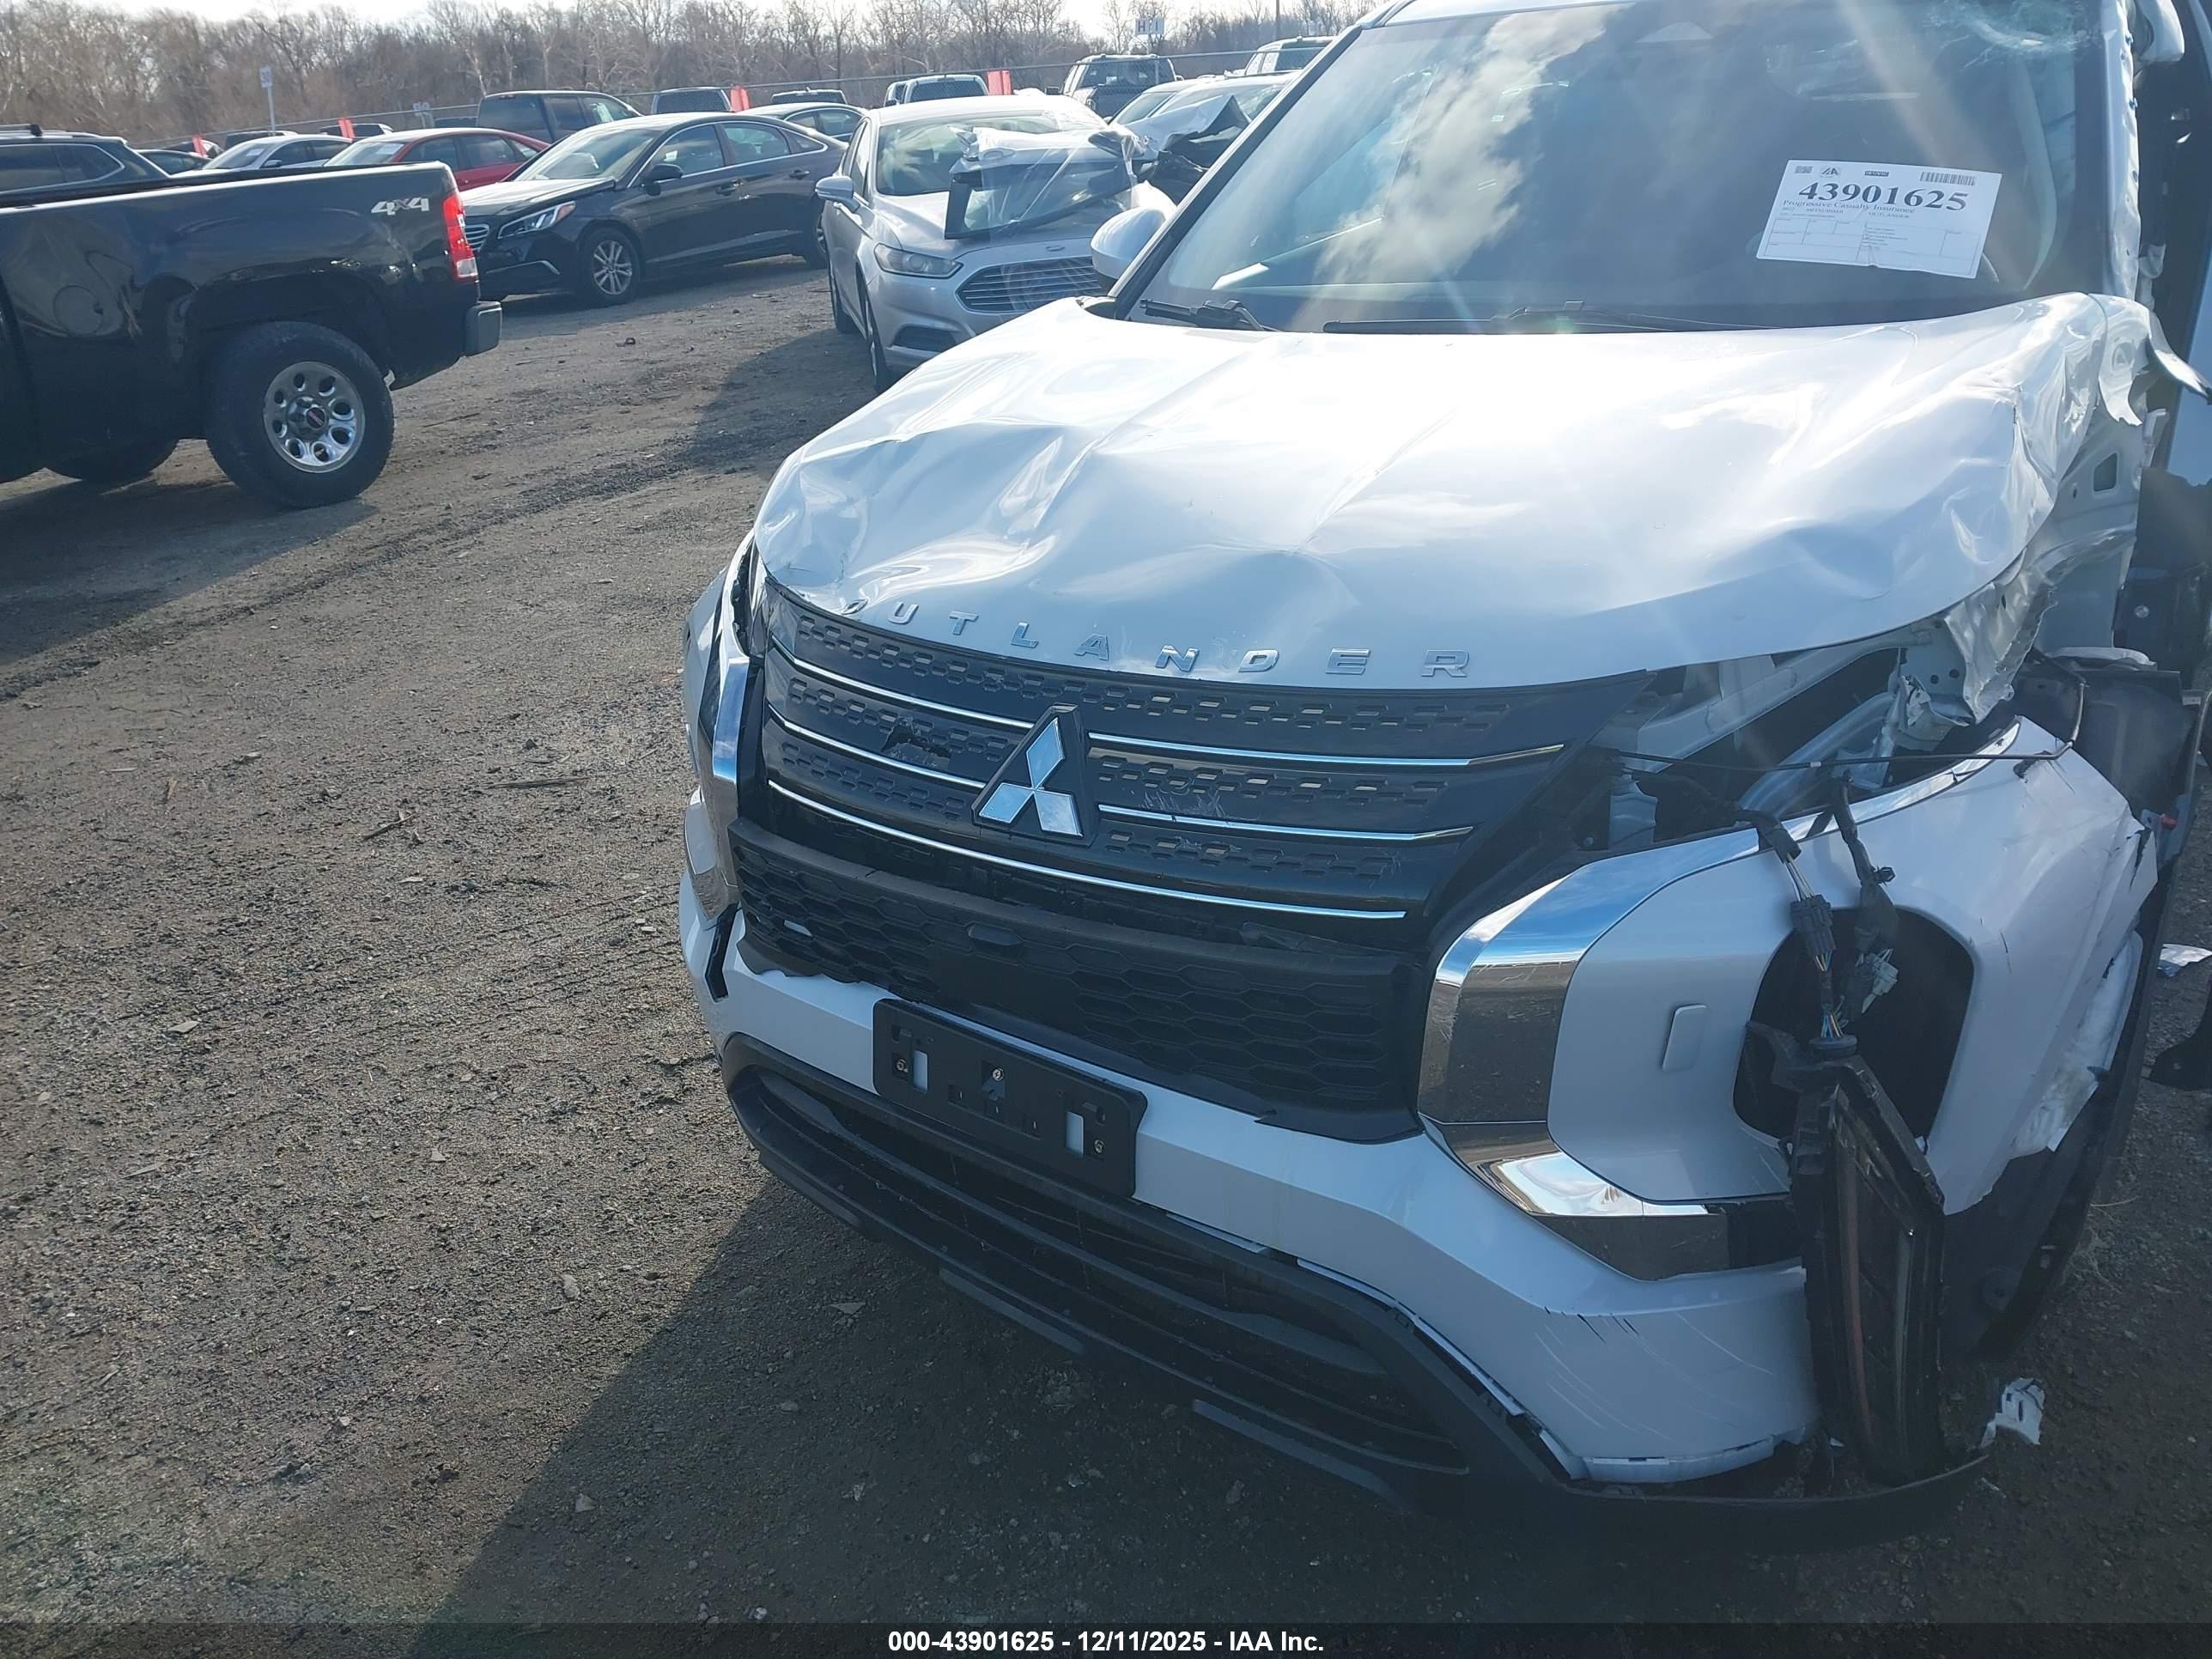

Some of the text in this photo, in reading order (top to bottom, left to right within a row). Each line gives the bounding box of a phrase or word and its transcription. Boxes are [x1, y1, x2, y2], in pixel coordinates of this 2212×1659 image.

[1783, 199, 1833, 208] Progressive
[1873, 204, 1916, 214] Insurance
[1798, 182, 1969, 211] 43901625
